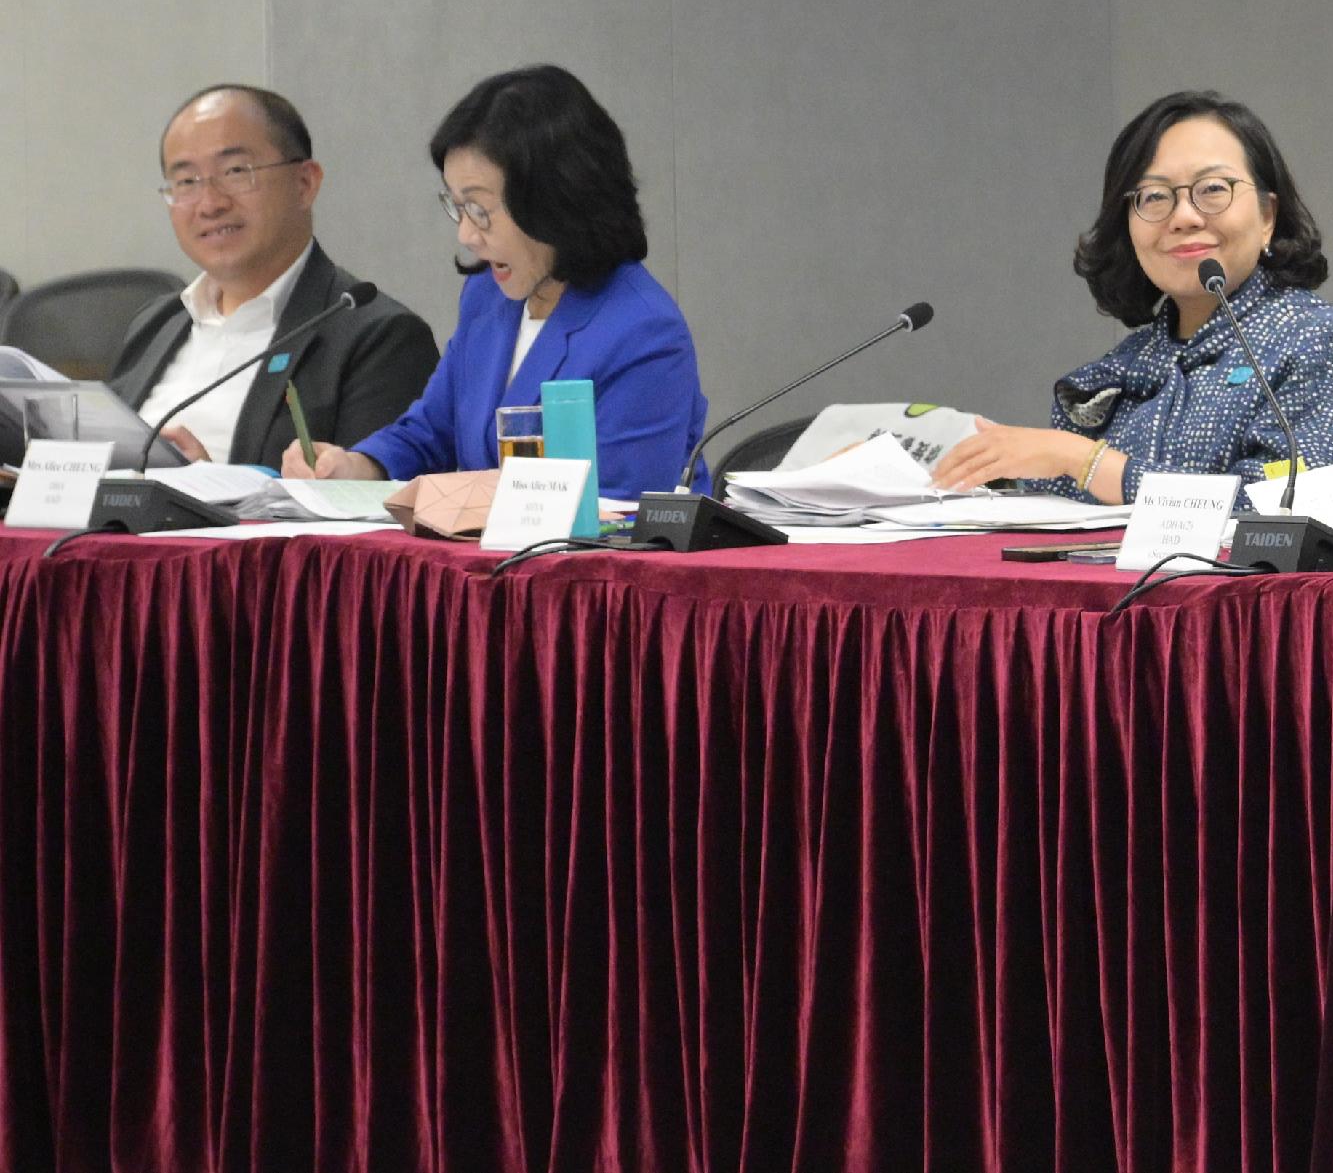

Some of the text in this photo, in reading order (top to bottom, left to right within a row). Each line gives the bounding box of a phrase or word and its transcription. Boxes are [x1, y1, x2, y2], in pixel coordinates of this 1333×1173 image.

[549, 481, 569, 492] MAK
[1143, 495, 1224, 511] Ms Vivian CHEUNG
[646, 509, 689, 524] TAIDEN
[1161, 534, 1181, 546] HAD
[1244, 531, 1293, 547] TAIDEN
